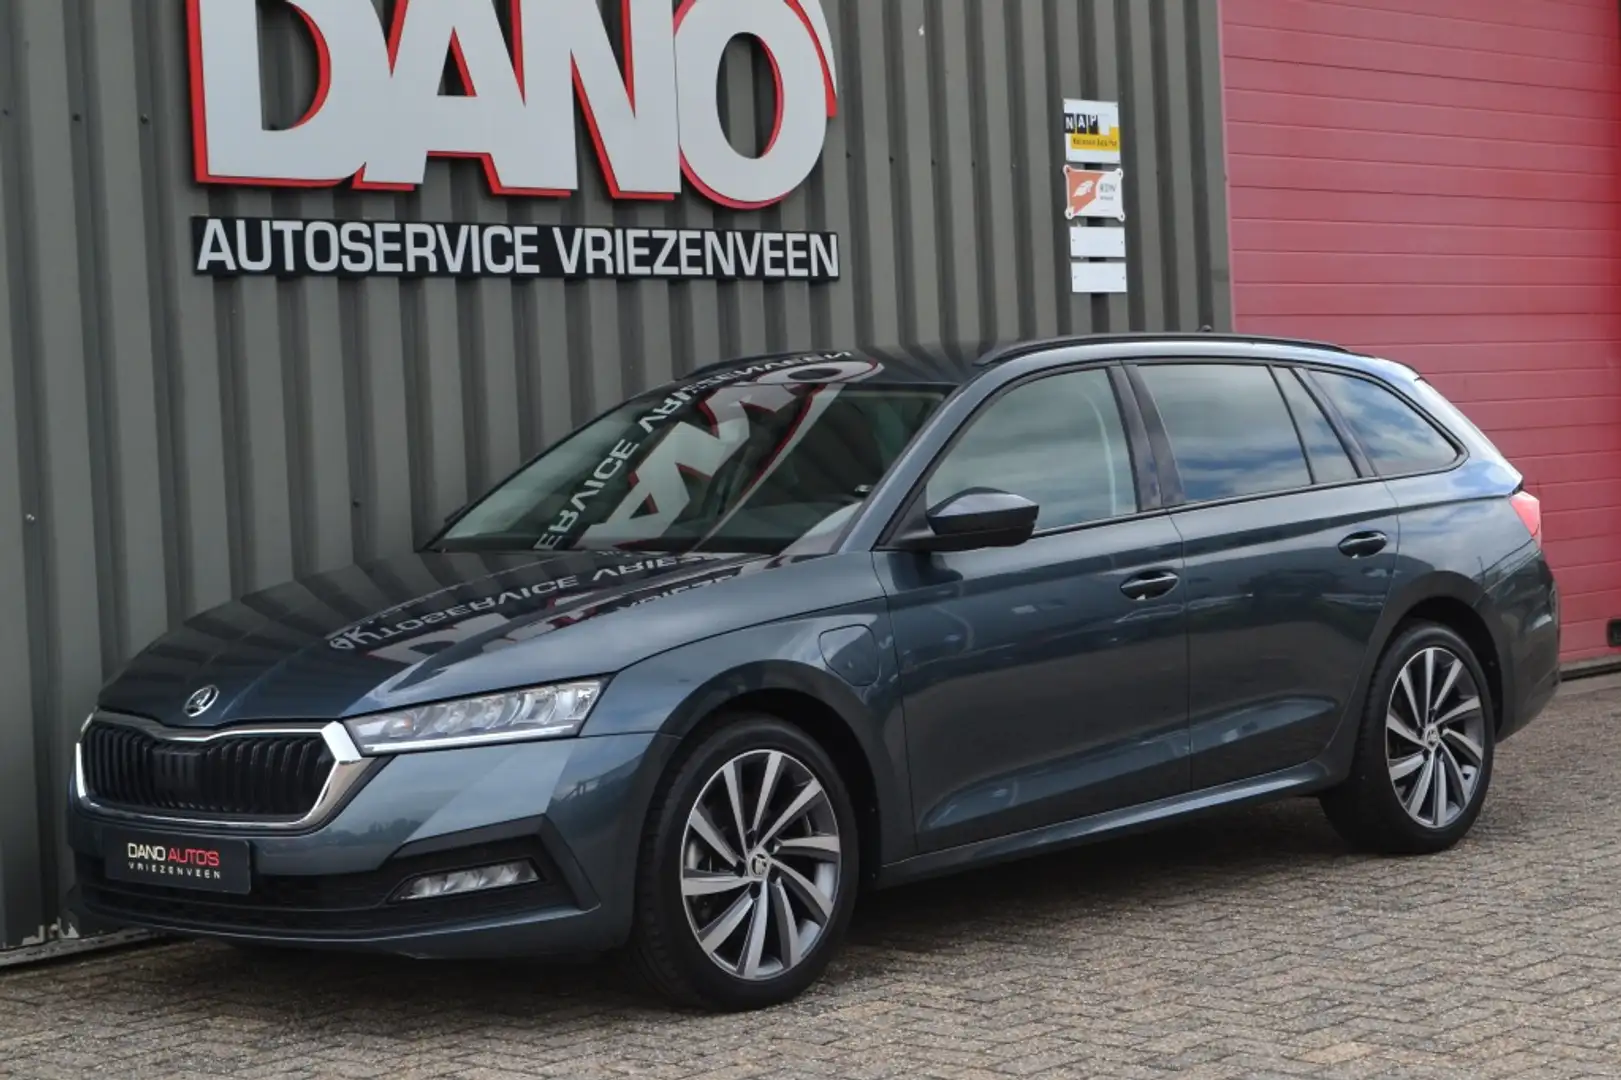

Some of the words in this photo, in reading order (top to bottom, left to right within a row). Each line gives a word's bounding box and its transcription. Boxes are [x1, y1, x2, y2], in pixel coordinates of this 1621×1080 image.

[187, 0, 837, 208] DANO
[1065, 113, 1098, 134] NAP
[197, 218, 540, 275] AUTOSERVICE
[553, 226, 839, 278] VRIEZENVEEN
[127, 842, 166, 861] DANO
[167, 847, 220, 867] AUTOS
[128, 862, 222, 879] VRIEZENVEEN
